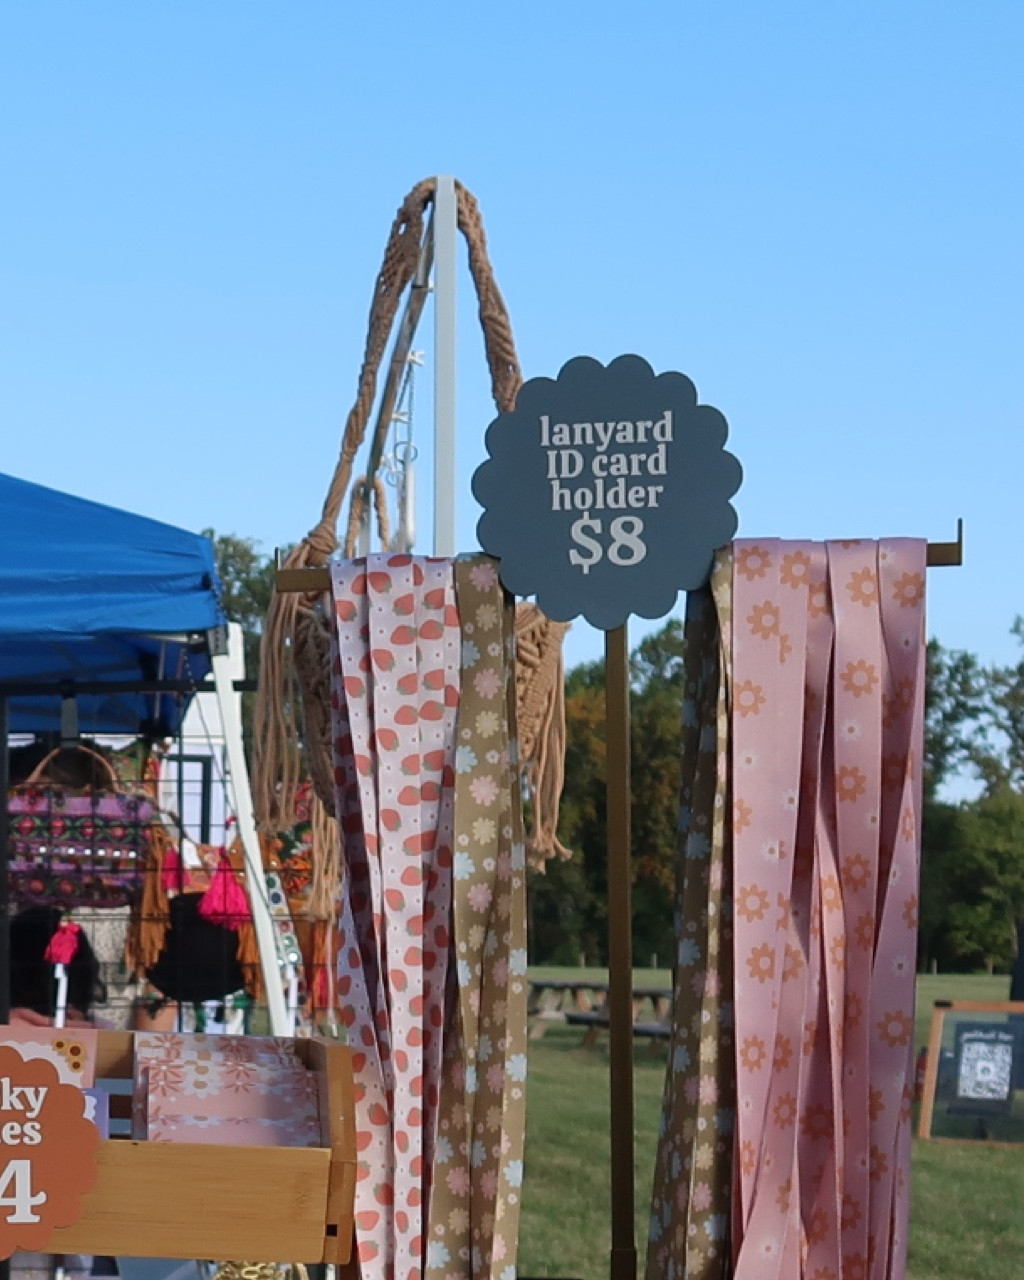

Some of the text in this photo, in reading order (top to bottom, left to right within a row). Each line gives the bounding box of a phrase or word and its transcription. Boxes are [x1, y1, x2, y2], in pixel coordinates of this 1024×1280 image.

[539, 410, 674, 452] lanyard
[546, 444, 667, 479] ID card
[551, 478, 664, 511] holder
[569, 511, 647, 575] $8
